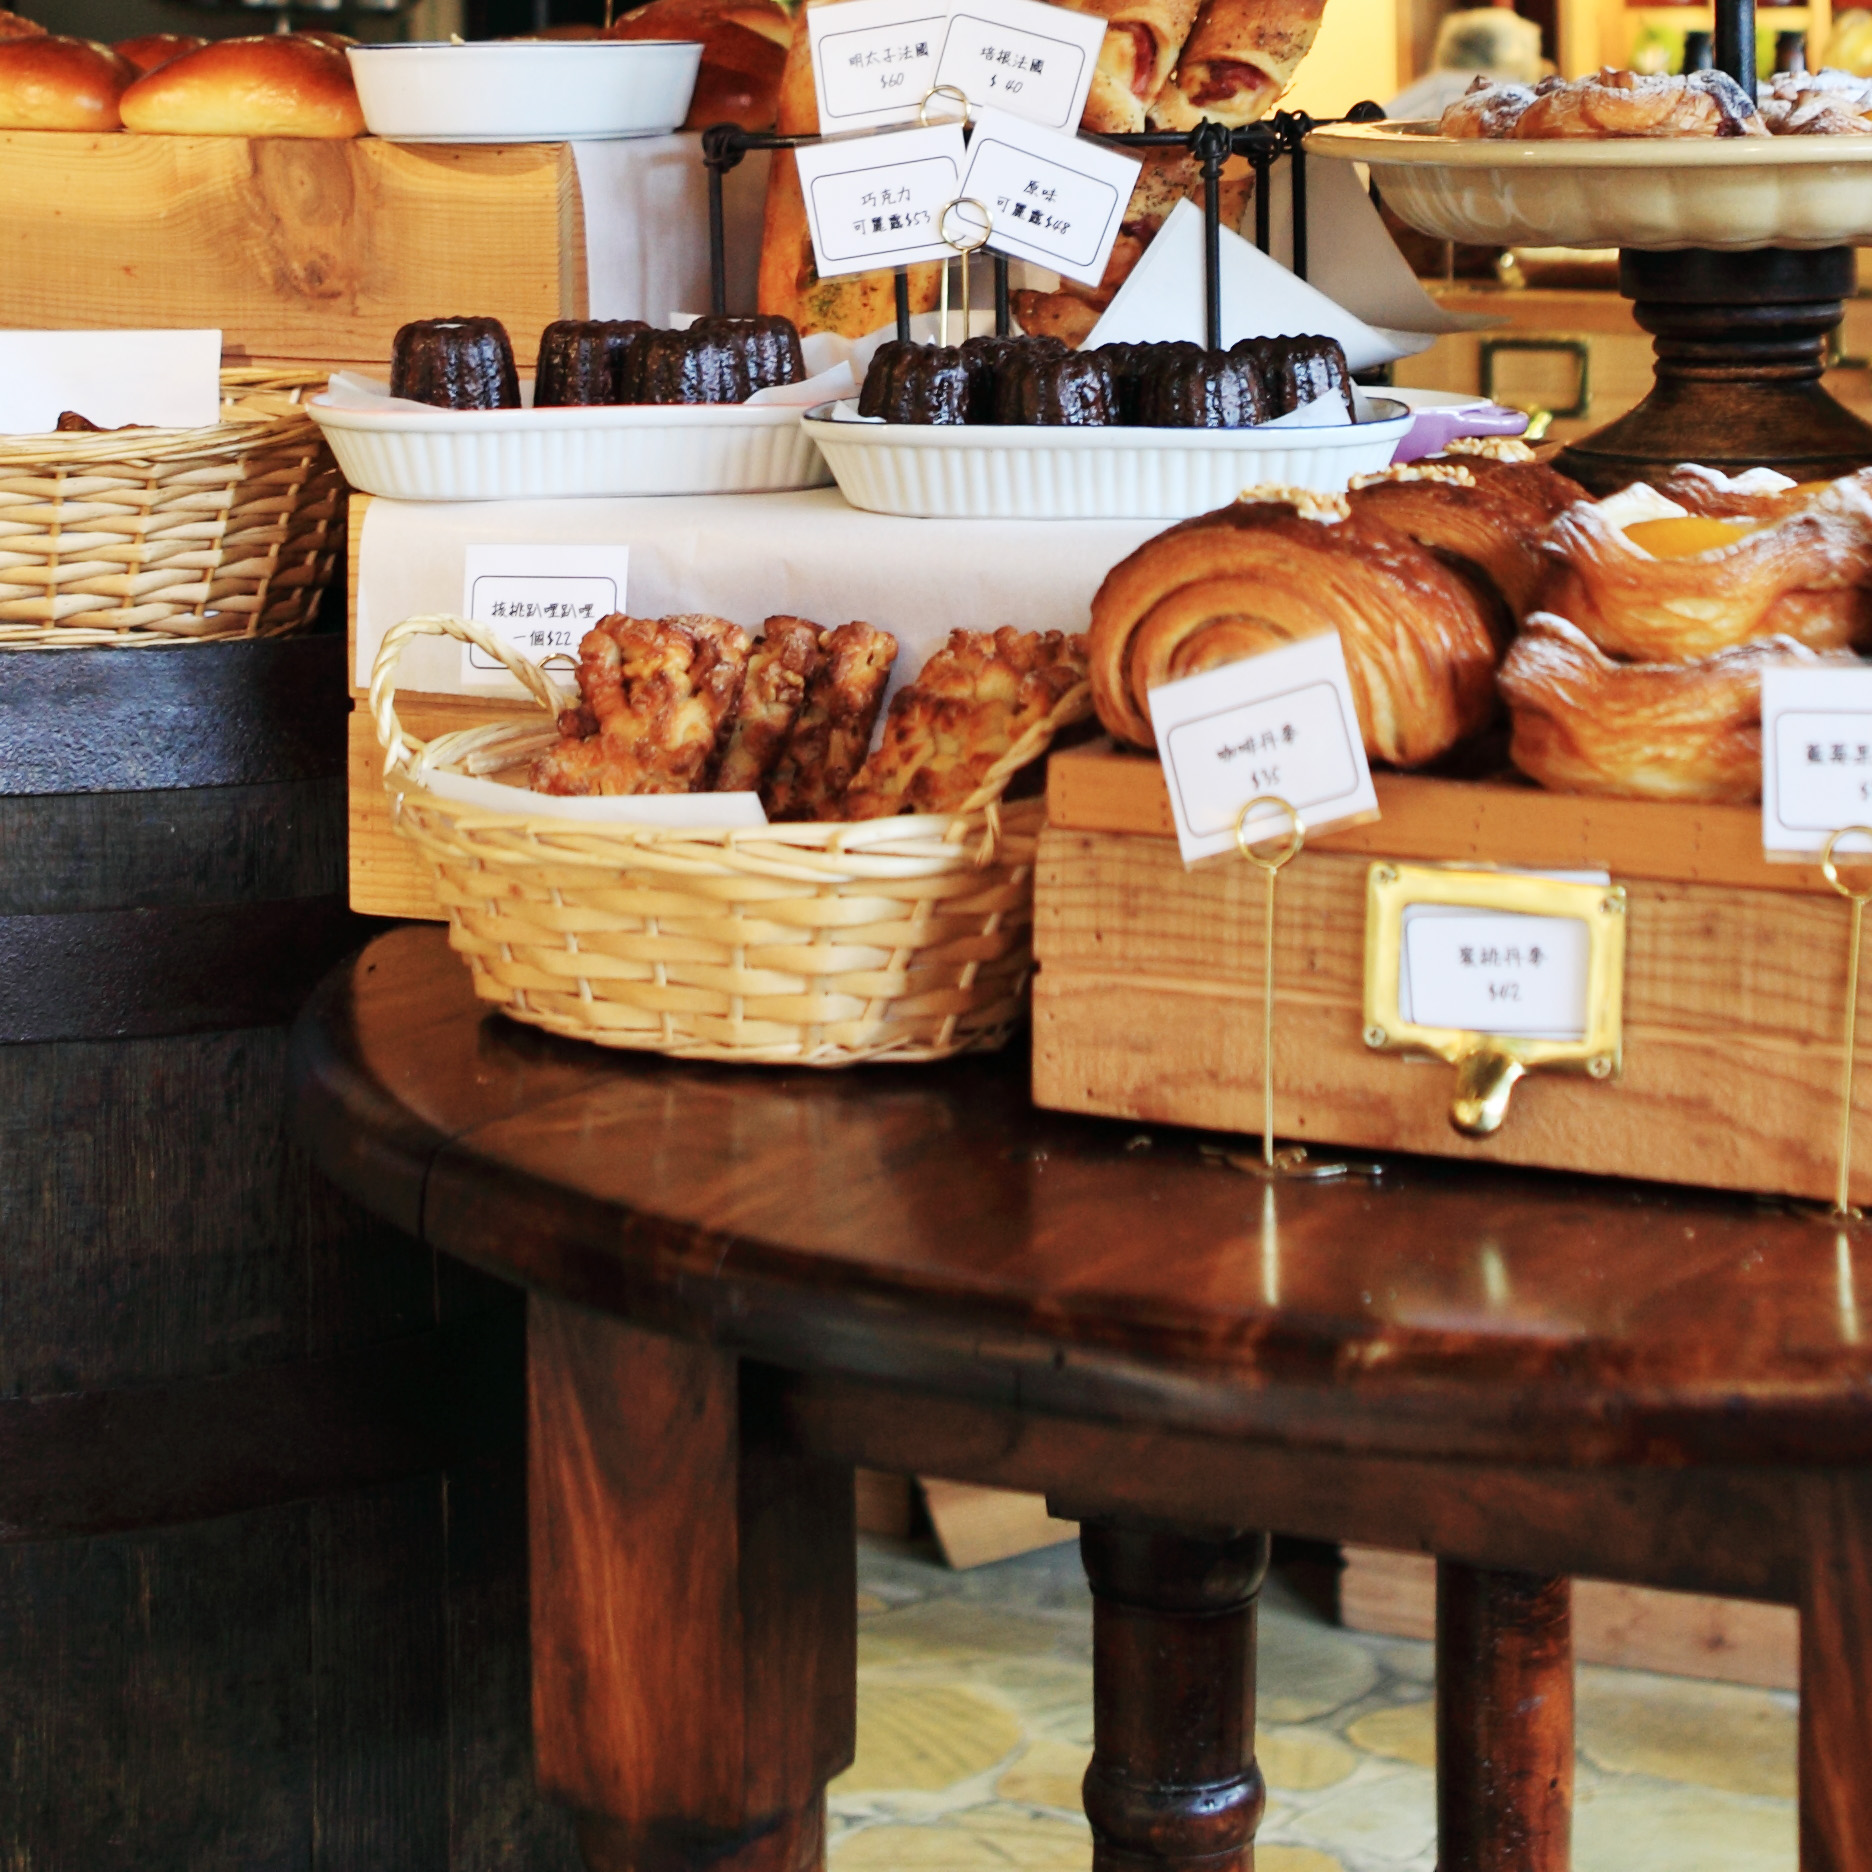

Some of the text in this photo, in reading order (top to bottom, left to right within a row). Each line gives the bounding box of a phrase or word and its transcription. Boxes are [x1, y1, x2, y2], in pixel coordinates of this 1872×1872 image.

[847, 41, 930, 69] 明太子法國
[979, 46, 1045, 75] 培根法國
[880, 72, 905, 89] $60
[860, 186, 912, 208] 巧克力
[1022, 179, 1058, 203] 原味
[513, 629, 572, 647] 一個$22
